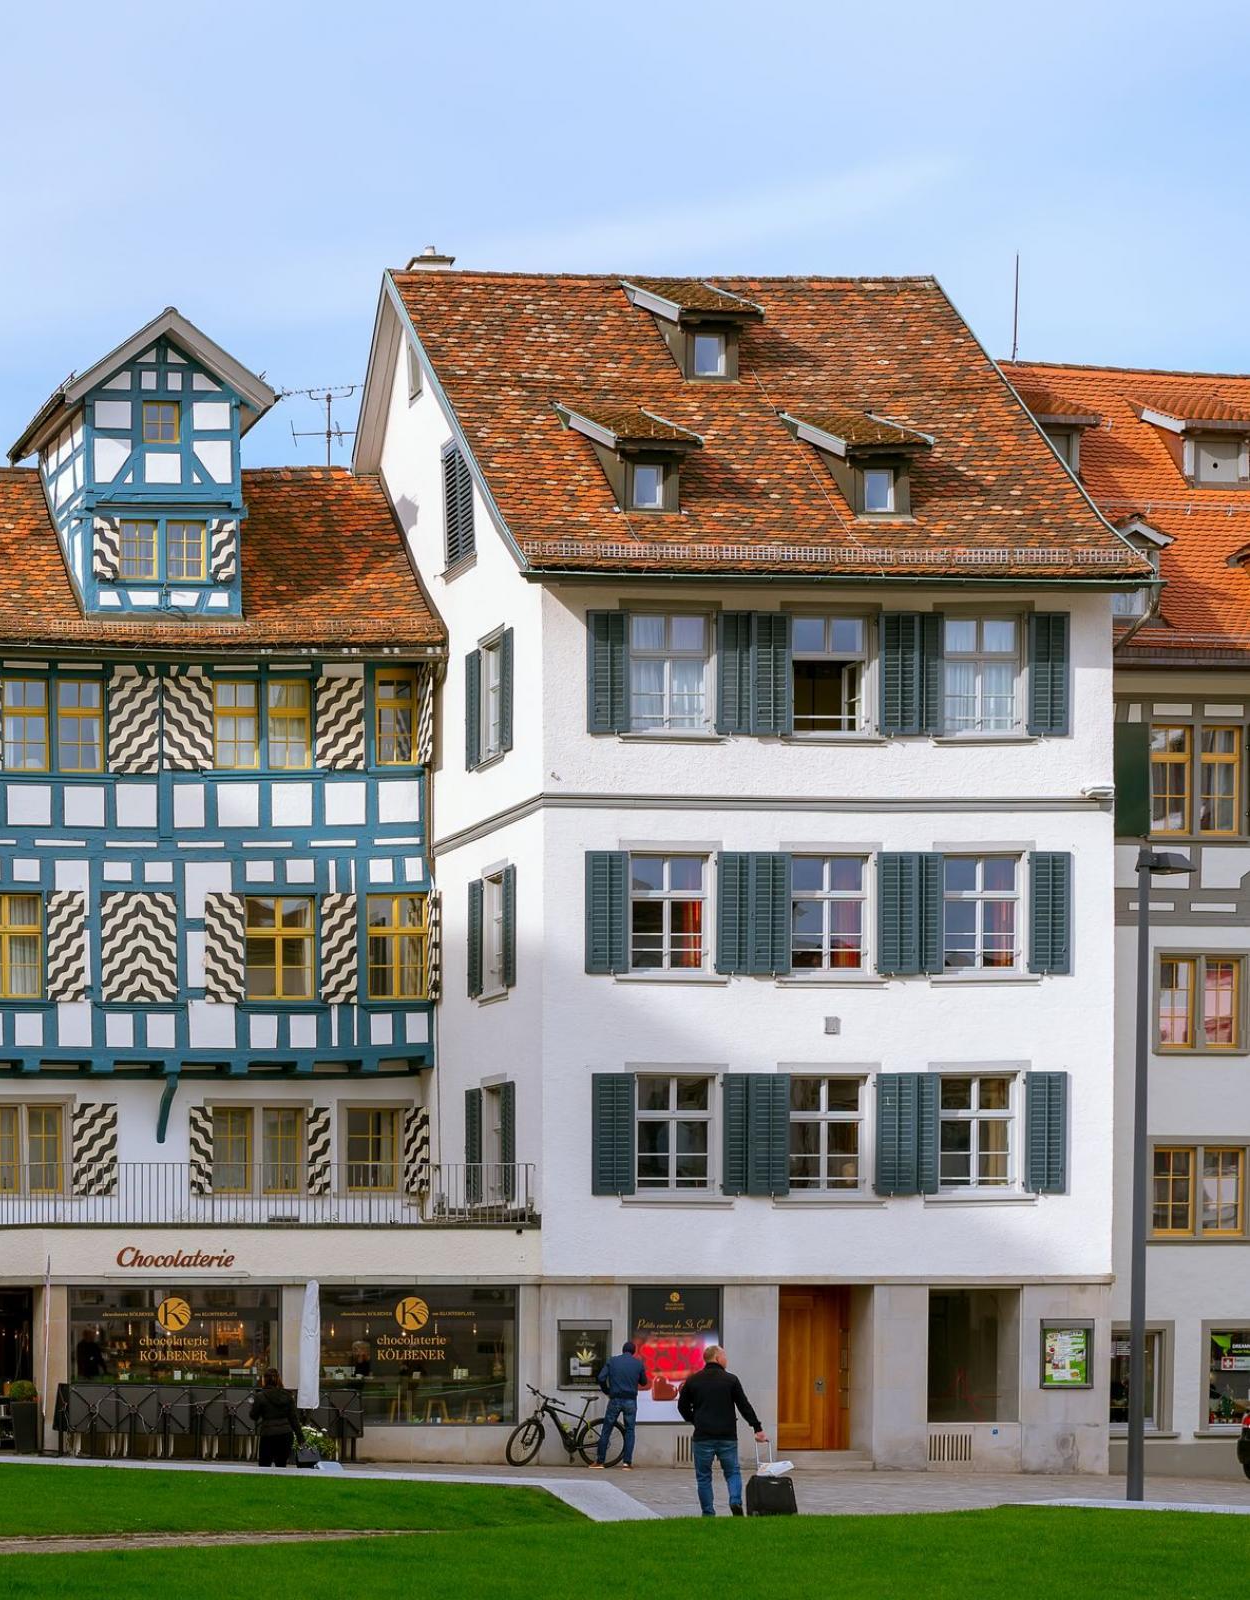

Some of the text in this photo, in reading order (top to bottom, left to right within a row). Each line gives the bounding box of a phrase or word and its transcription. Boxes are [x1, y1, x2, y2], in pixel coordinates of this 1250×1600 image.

[116, 1246, 235, 1268] Chocolaterie
[139, 1335, 209, 1346] chocolaterie
[377, 1335, 447, 1346] chocolaterie
[139, 1349, 208, 1361] KÖLBENER
[377, 1348, 446, 1360] KÖLBENER
